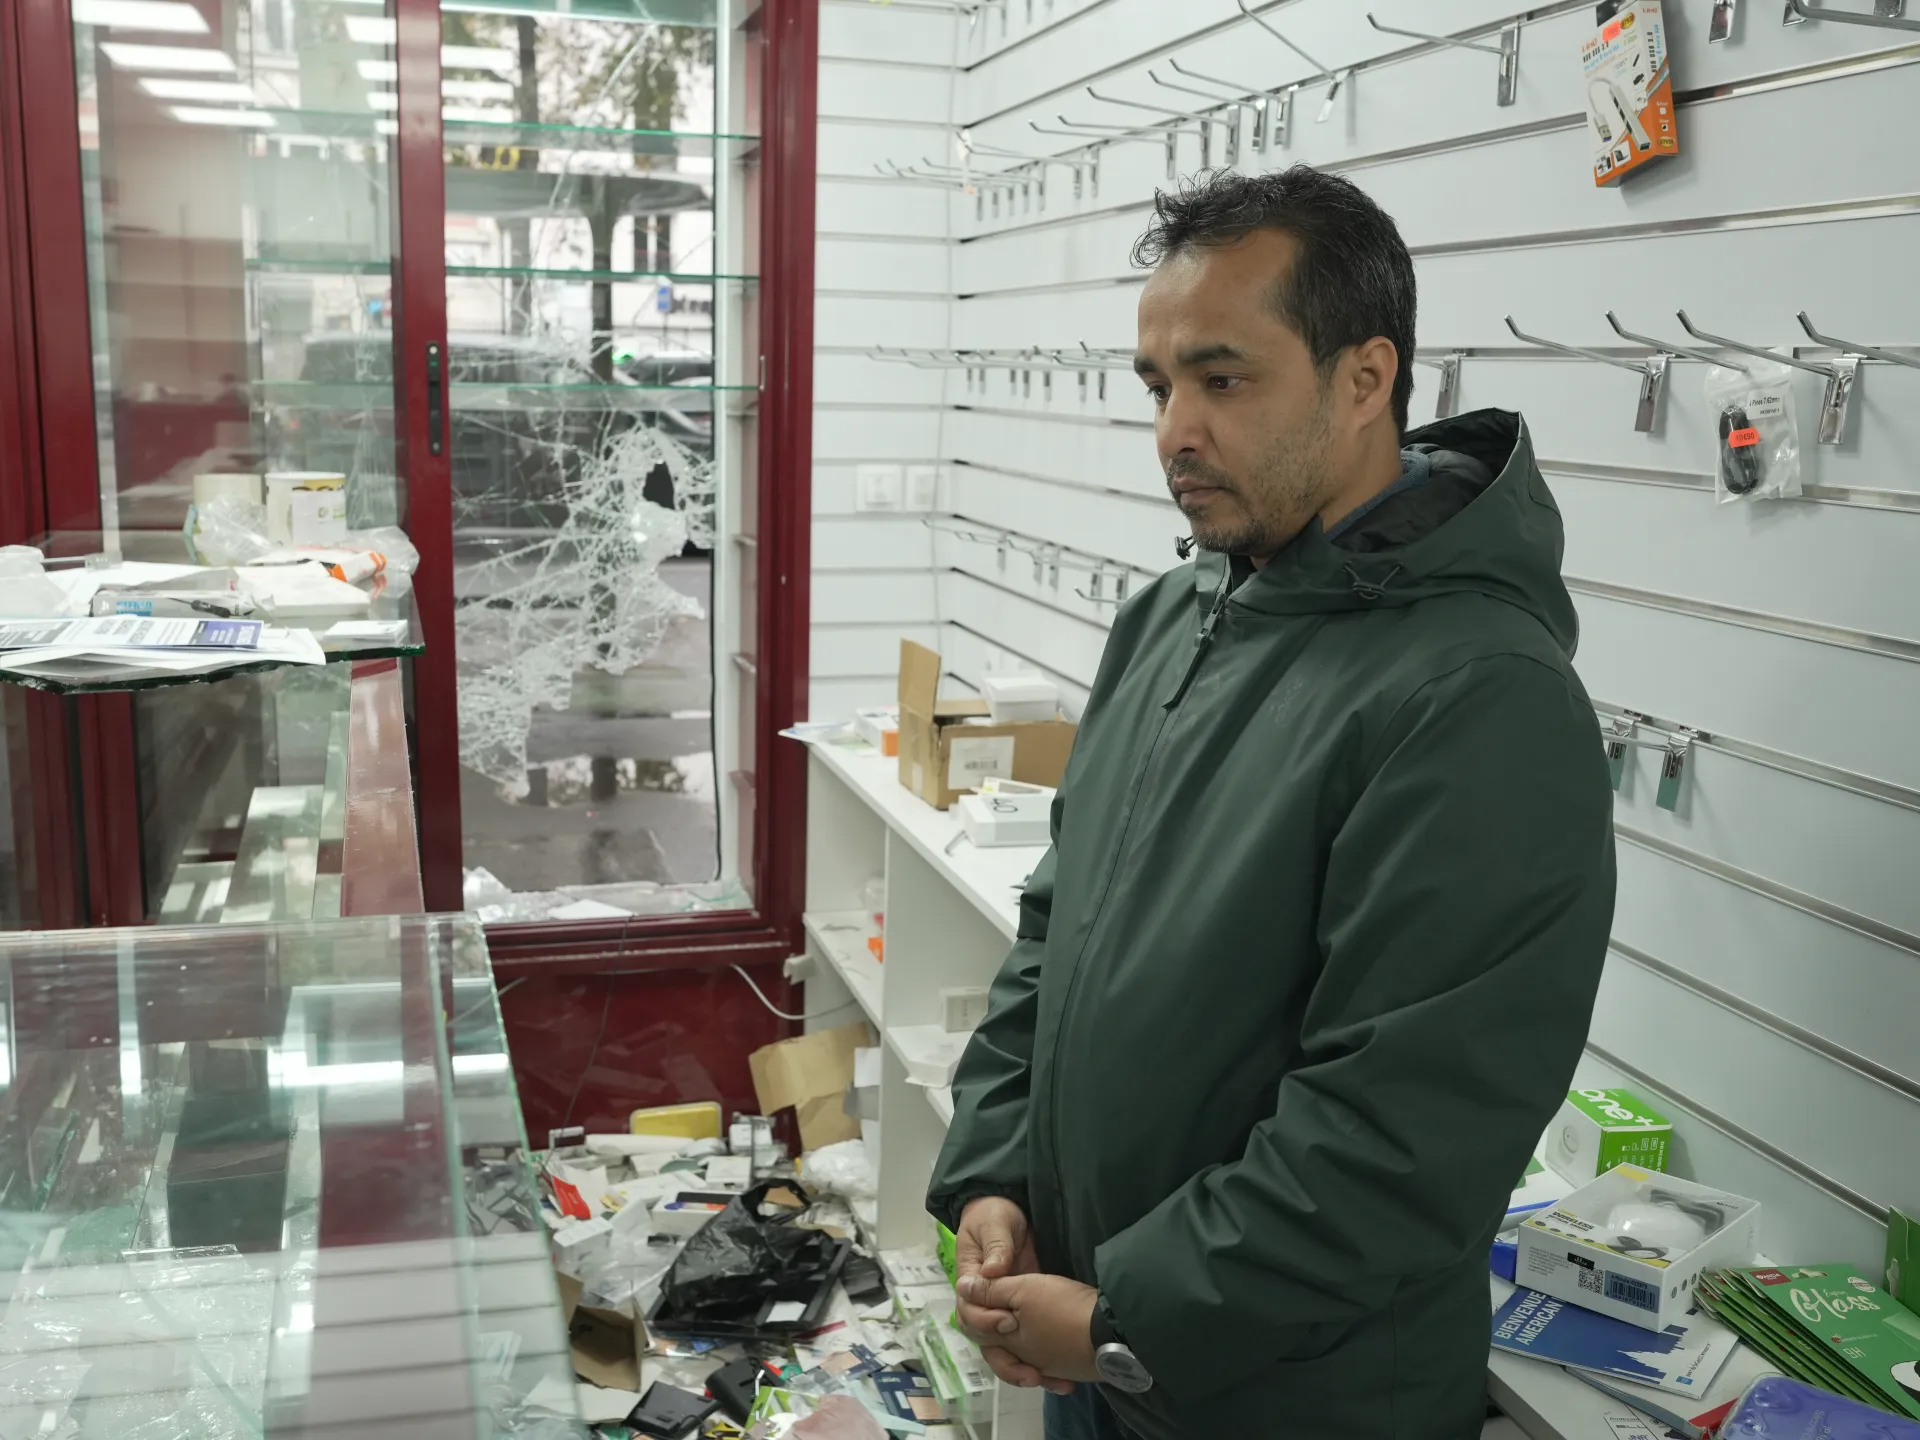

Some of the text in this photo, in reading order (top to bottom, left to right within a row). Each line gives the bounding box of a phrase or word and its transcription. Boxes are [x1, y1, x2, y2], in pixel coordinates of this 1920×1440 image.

[1552, 1211, 1595, 1230] WIRELESS
[1494, 1290, 1547, 1340] BIENVENUE
[1515, 1301, 1564, 1345] AMERICAN
[1789, 1288, 1881, 1322] Glass
